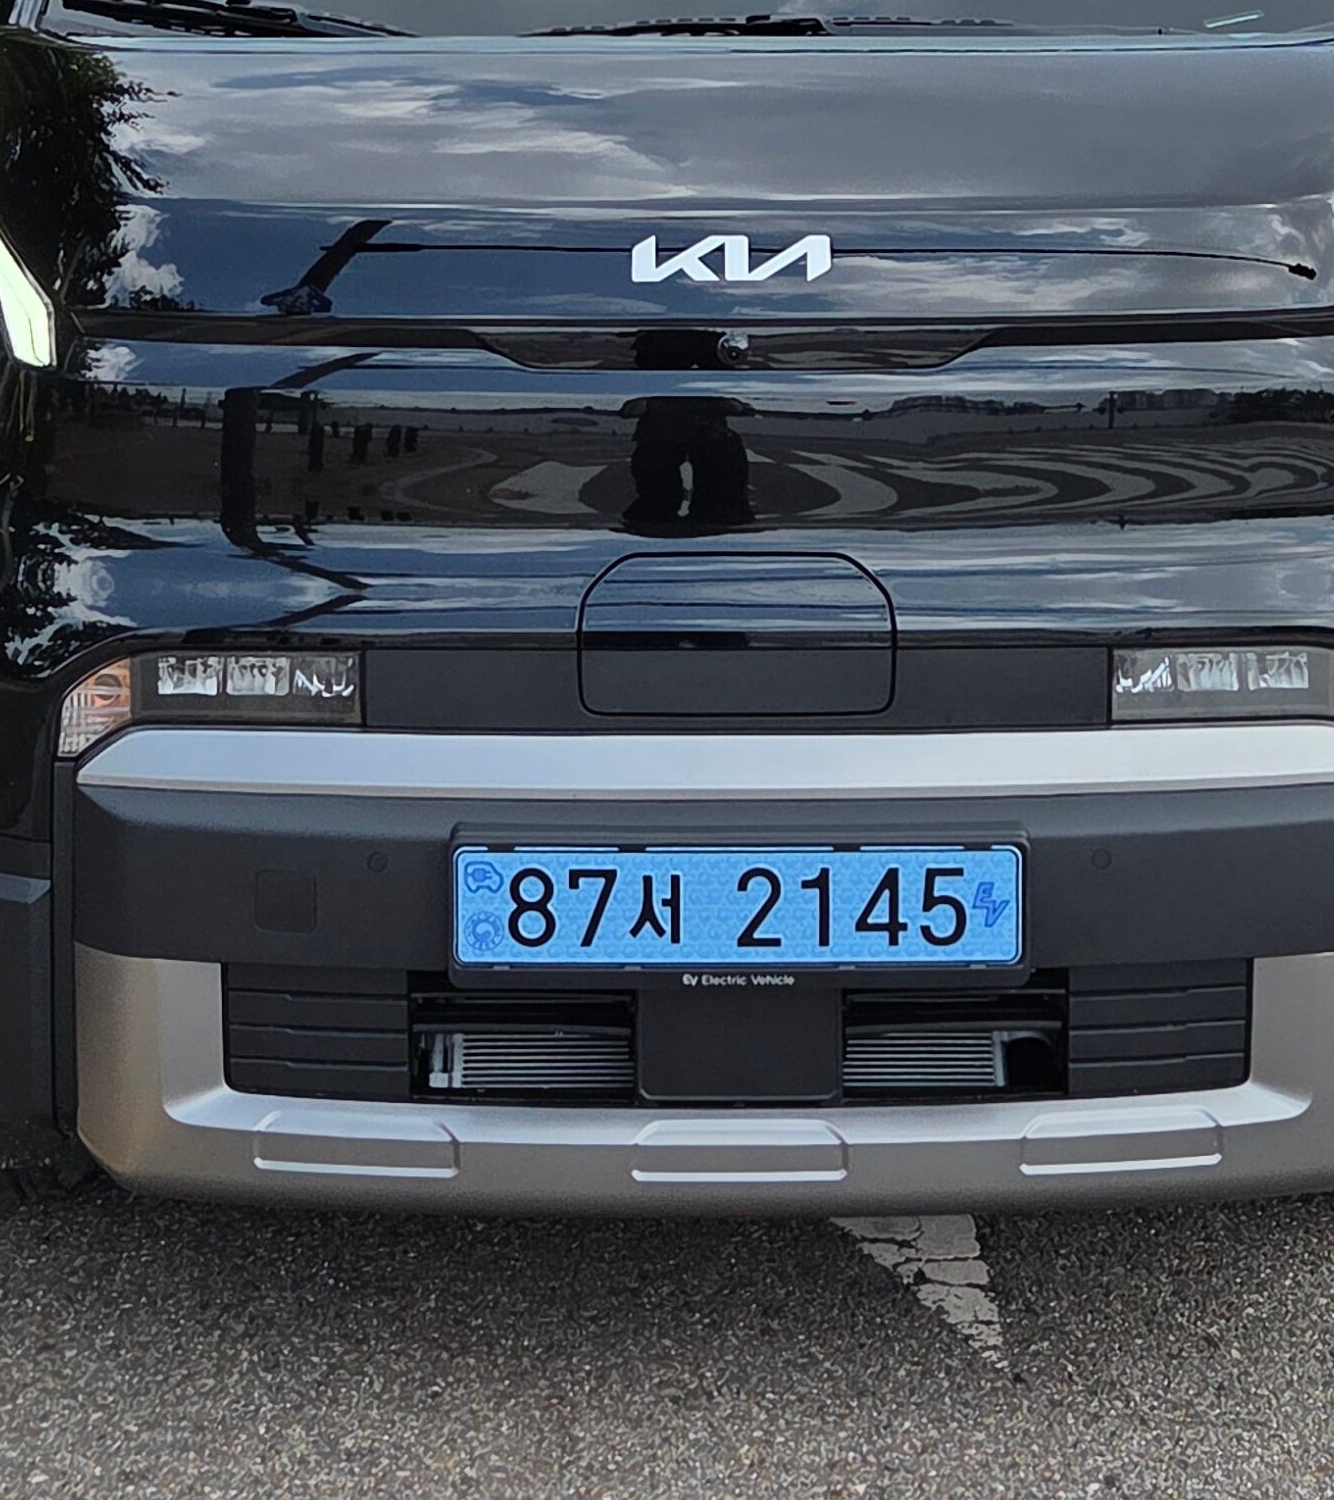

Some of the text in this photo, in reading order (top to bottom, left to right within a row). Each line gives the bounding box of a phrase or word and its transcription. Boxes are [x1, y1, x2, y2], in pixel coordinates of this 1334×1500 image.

[630, 234, 833, 283] KIA
[507, 866, 967, 948] 87서 2145
[701, 974, 747, 986] Electric
[750, 974, 795, 986] Vehicle
